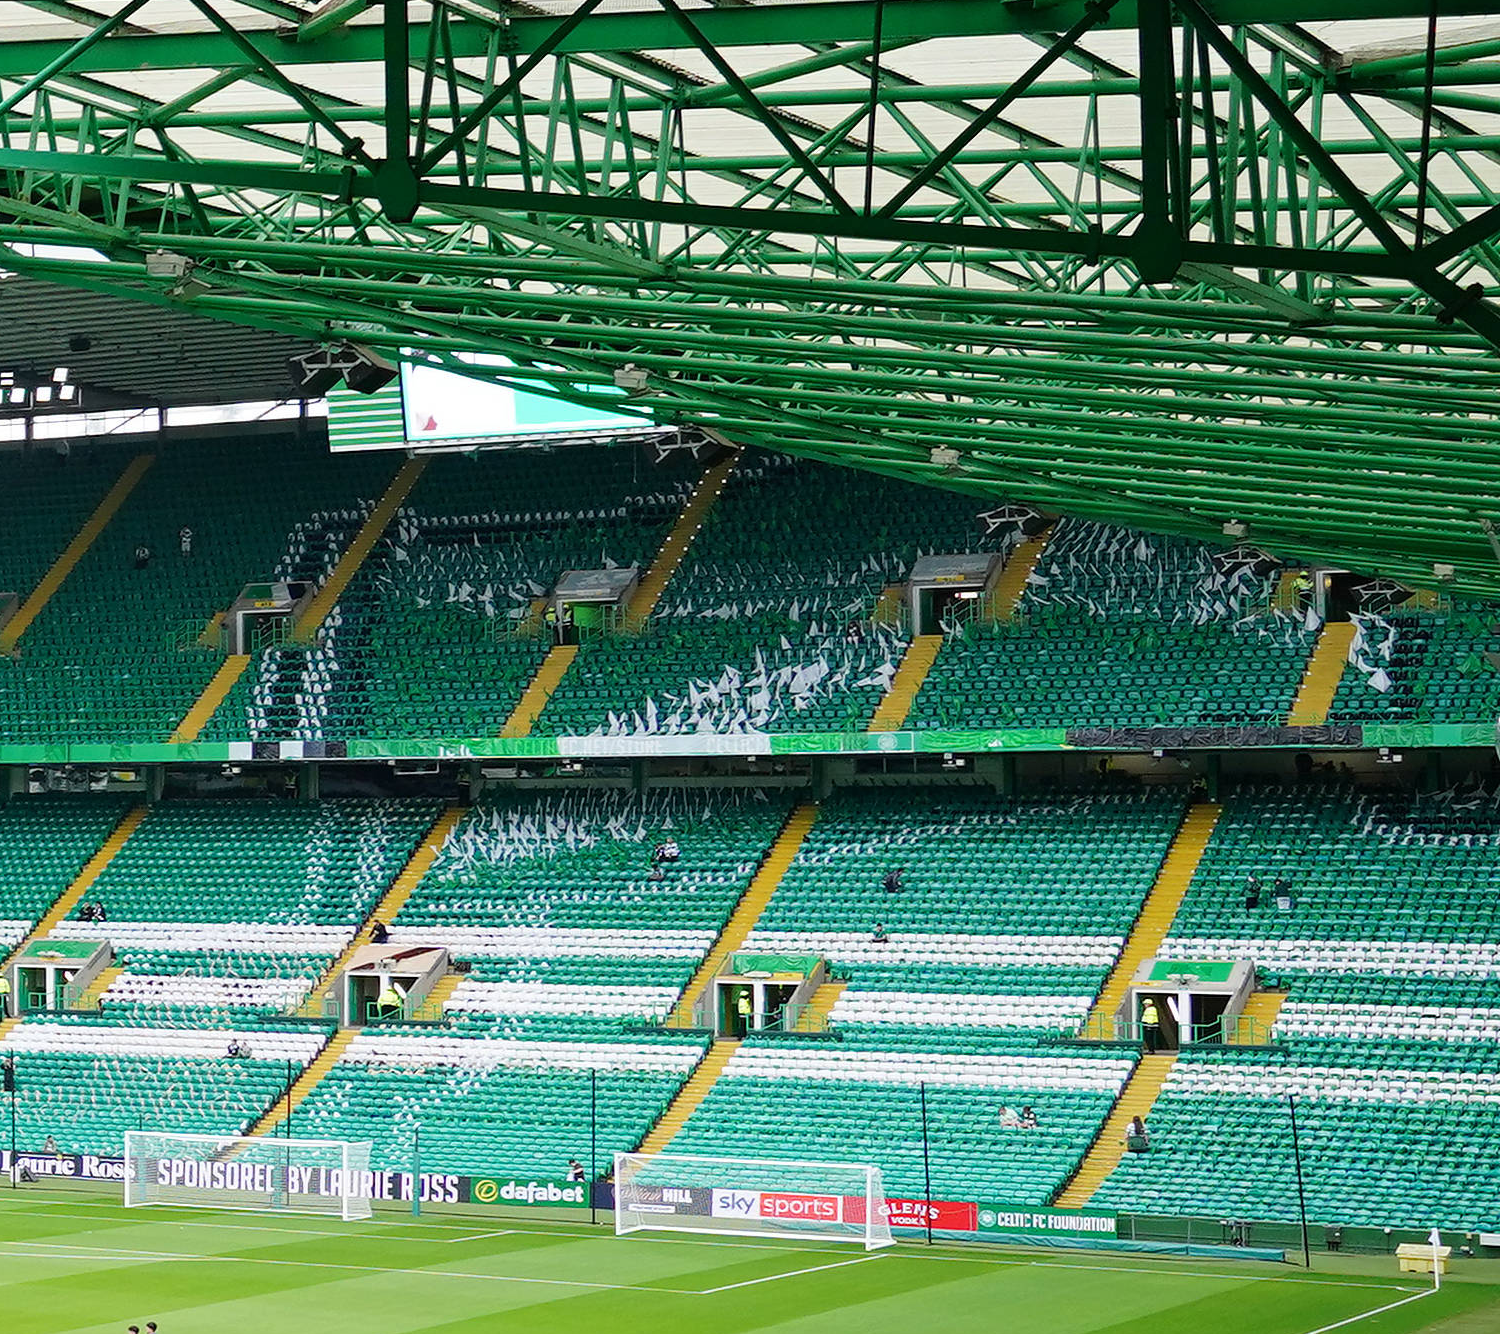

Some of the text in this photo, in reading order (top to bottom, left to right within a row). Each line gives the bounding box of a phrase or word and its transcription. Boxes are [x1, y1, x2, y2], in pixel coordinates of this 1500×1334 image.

[81, 1155, 136, 1179] Ross
[286, 1166, 312, 1195] BY
[318, 1167, 394, 1200] LAURIE
[401, 1172, 458, 1204] ROSS
[500, 1180, 584, 1203] dafabet
[663, 1187, 693, 1203] HILL
[719, 1192, 835, 1216] sky sports
[996, 1211, 1116, 1232] CELTIC FC FOUNDATION
